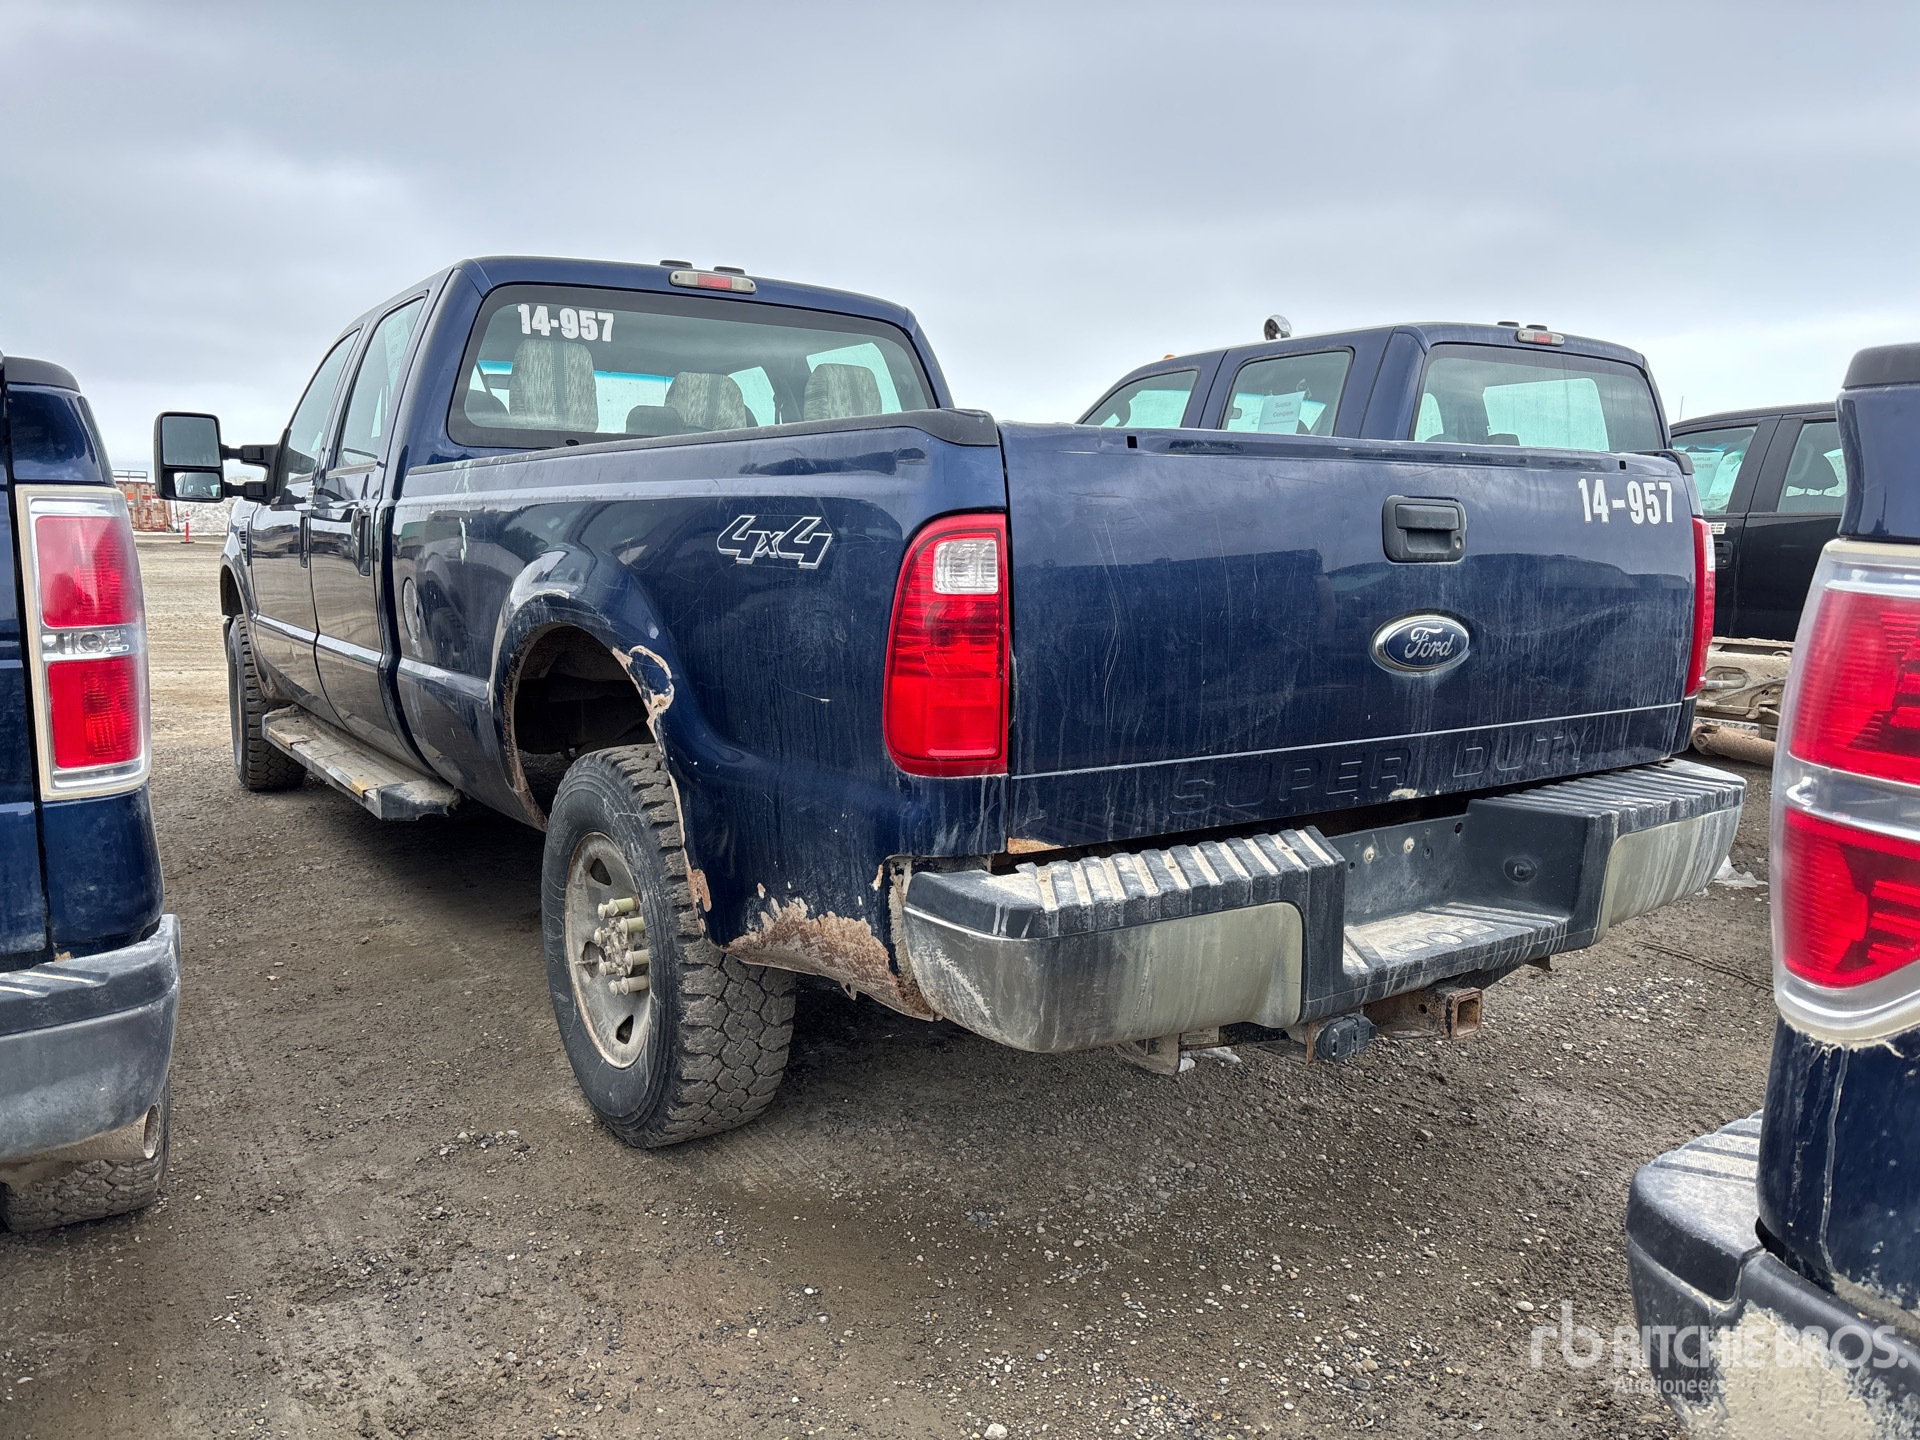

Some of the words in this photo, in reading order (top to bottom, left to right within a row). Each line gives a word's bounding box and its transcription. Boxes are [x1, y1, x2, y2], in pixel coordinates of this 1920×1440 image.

[518, 303, 614, 342] 14-957
[1577, 478, 1673, 525] 14-957
[717, 514, 833, 570] 4x4
[1404, 626, 1456, 659] Ford
[1169, 746, 1411, 815] SUPER
[1452, 722, 1596, 778] DUTY
